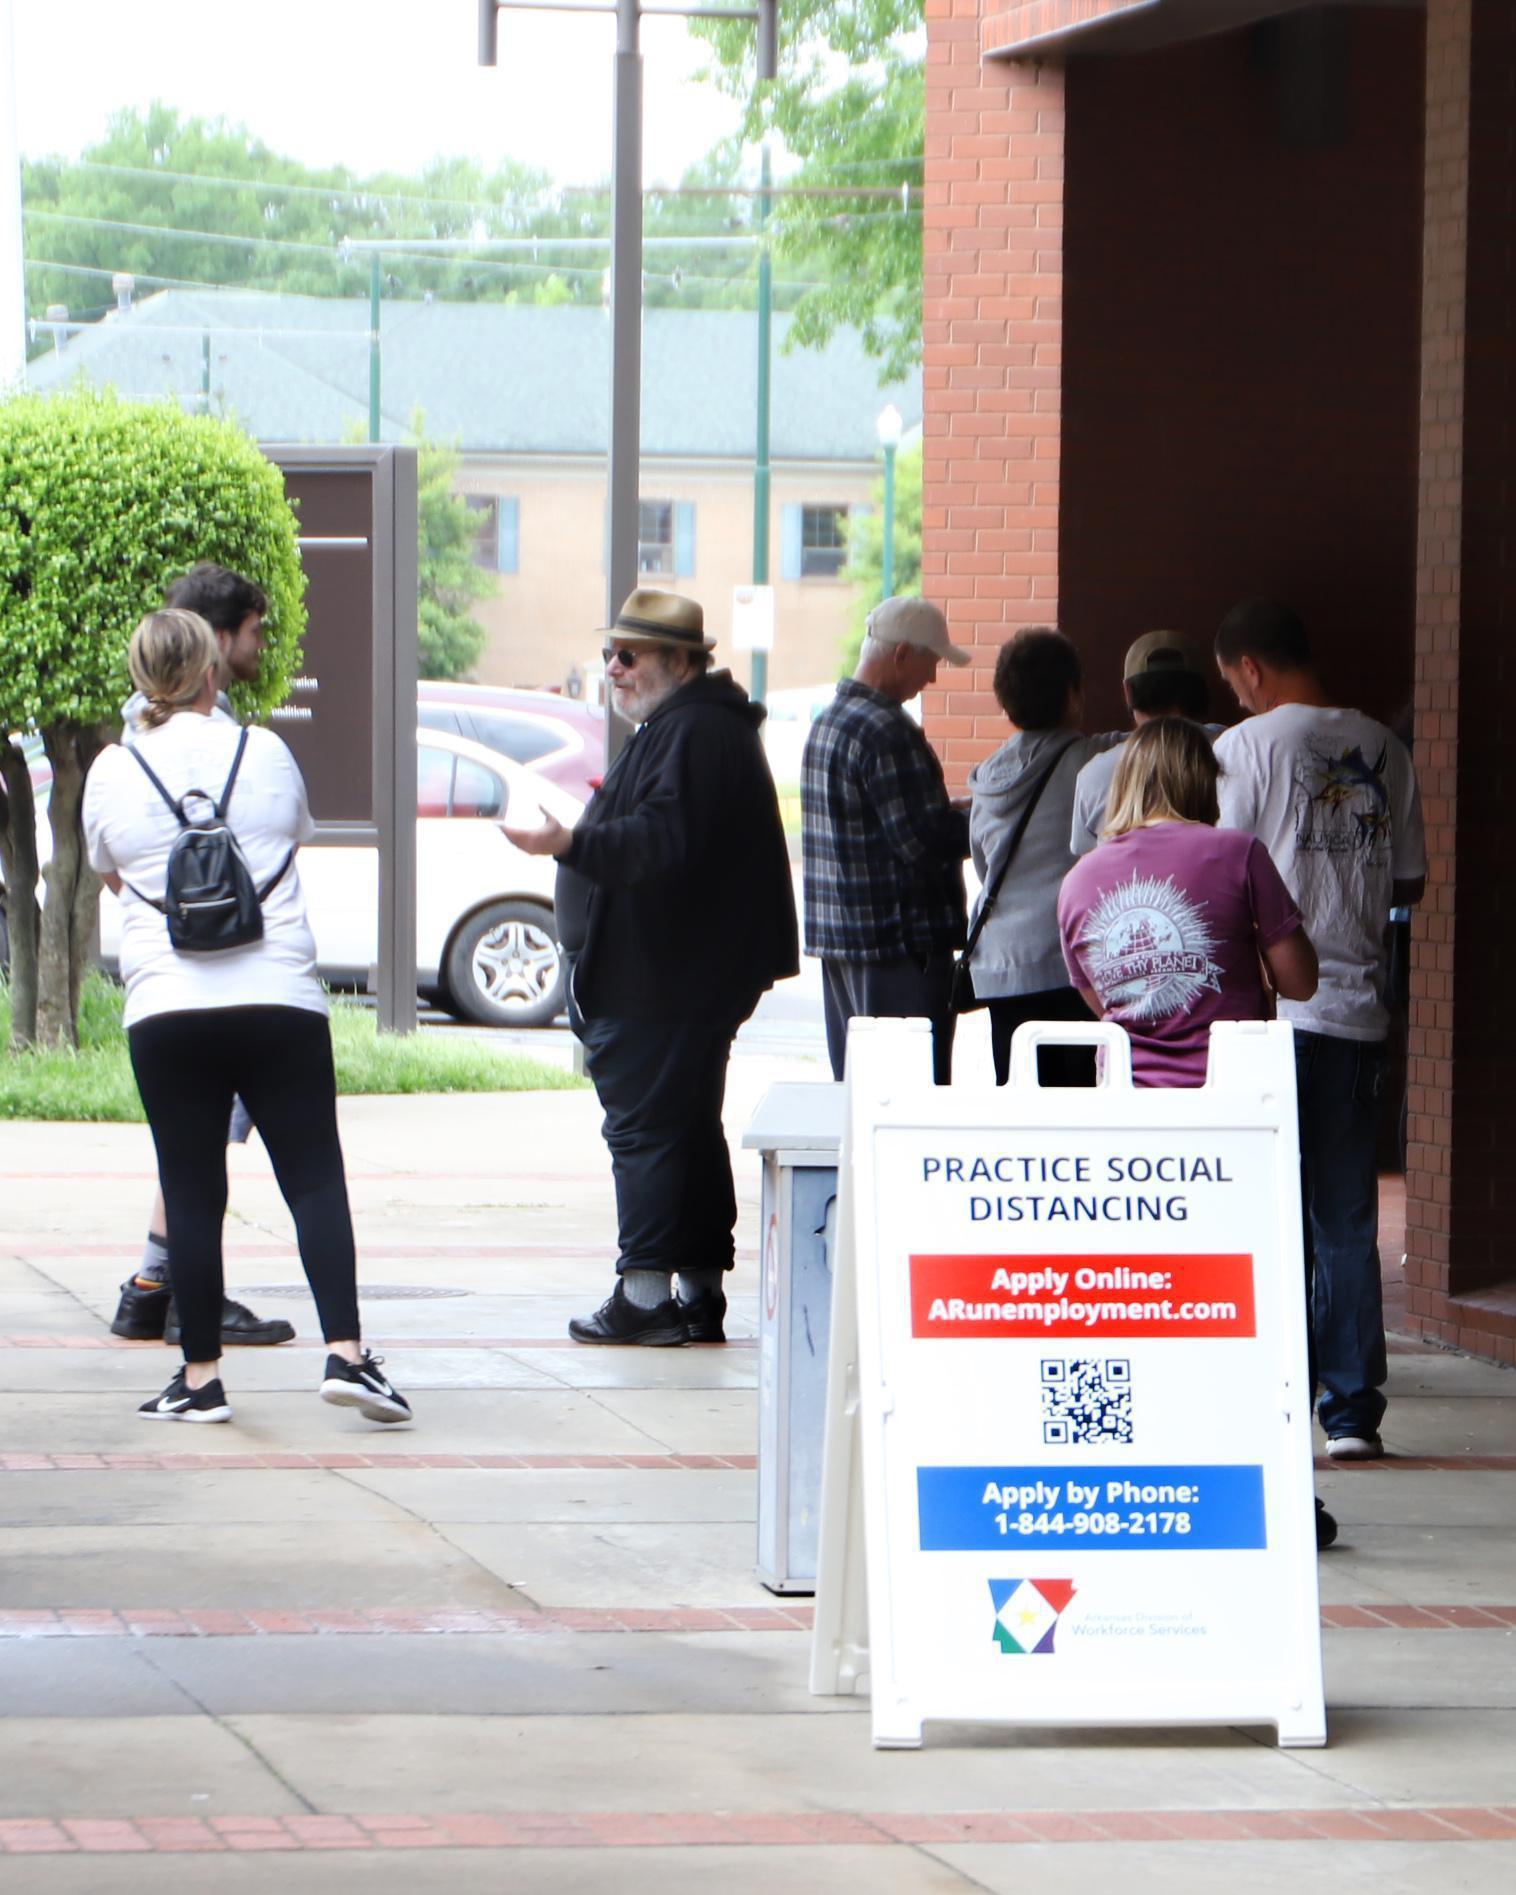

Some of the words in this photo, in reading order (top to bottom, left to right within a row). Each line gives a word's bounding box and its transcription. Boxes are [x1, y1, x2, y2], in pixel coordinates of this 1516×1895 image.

[271, 704, 312, 719] onditions
[1125, 957, 1149, 975] THY
[1152, 954, 1201, 970] PLANET
[922, 1157, 1092, 1183] PRACTICE
[1107, 1156, 1234, 1183] SOCIAL
[969, 1196, 1189, 1222] DISTANCING
[990, 1267, 1070, 1296] Apply
[1074, 1266, 1173, 1290] Online:
[927, 1297, 1238, 1327] ARunemployment.com
[982, 1481, 1061, 1510] Apply
[1066, 1481, 1100, 1510] by
[1106, 1481, 1200, 1505] Phone:
[994, 1511, 1192, 1535] 1-844-908-2178
[1071, 1623, 1145, 1636] Workforce
[1148, 1623, 1207, 1636] Services
